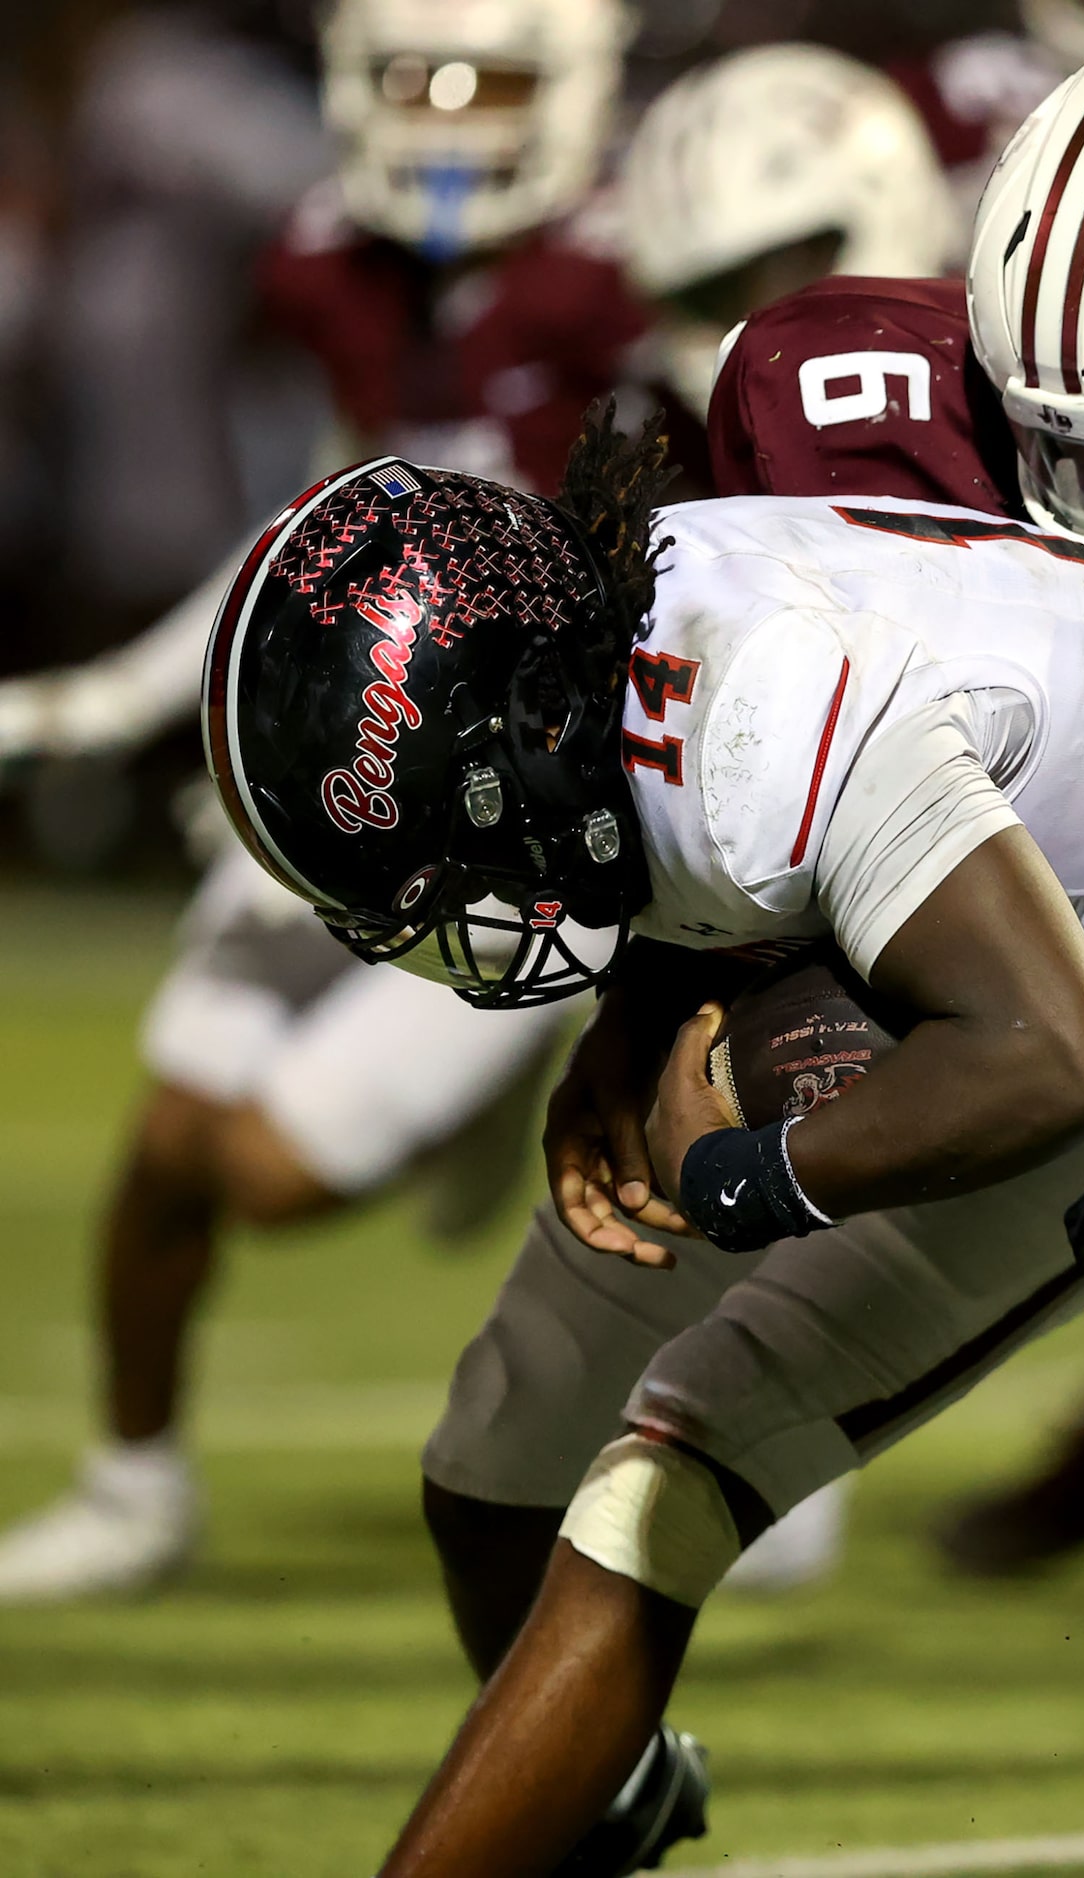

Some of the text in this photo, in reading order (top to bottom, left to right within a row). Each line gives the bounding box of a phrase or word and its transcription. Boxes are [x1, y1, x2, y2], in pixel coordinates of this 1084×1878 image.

[798, 350, 932, 427] 6
[321, 588, 423, 834] Bengals
[621, 646, 702, 787] 14
[528, 900, 562, 929] 14
